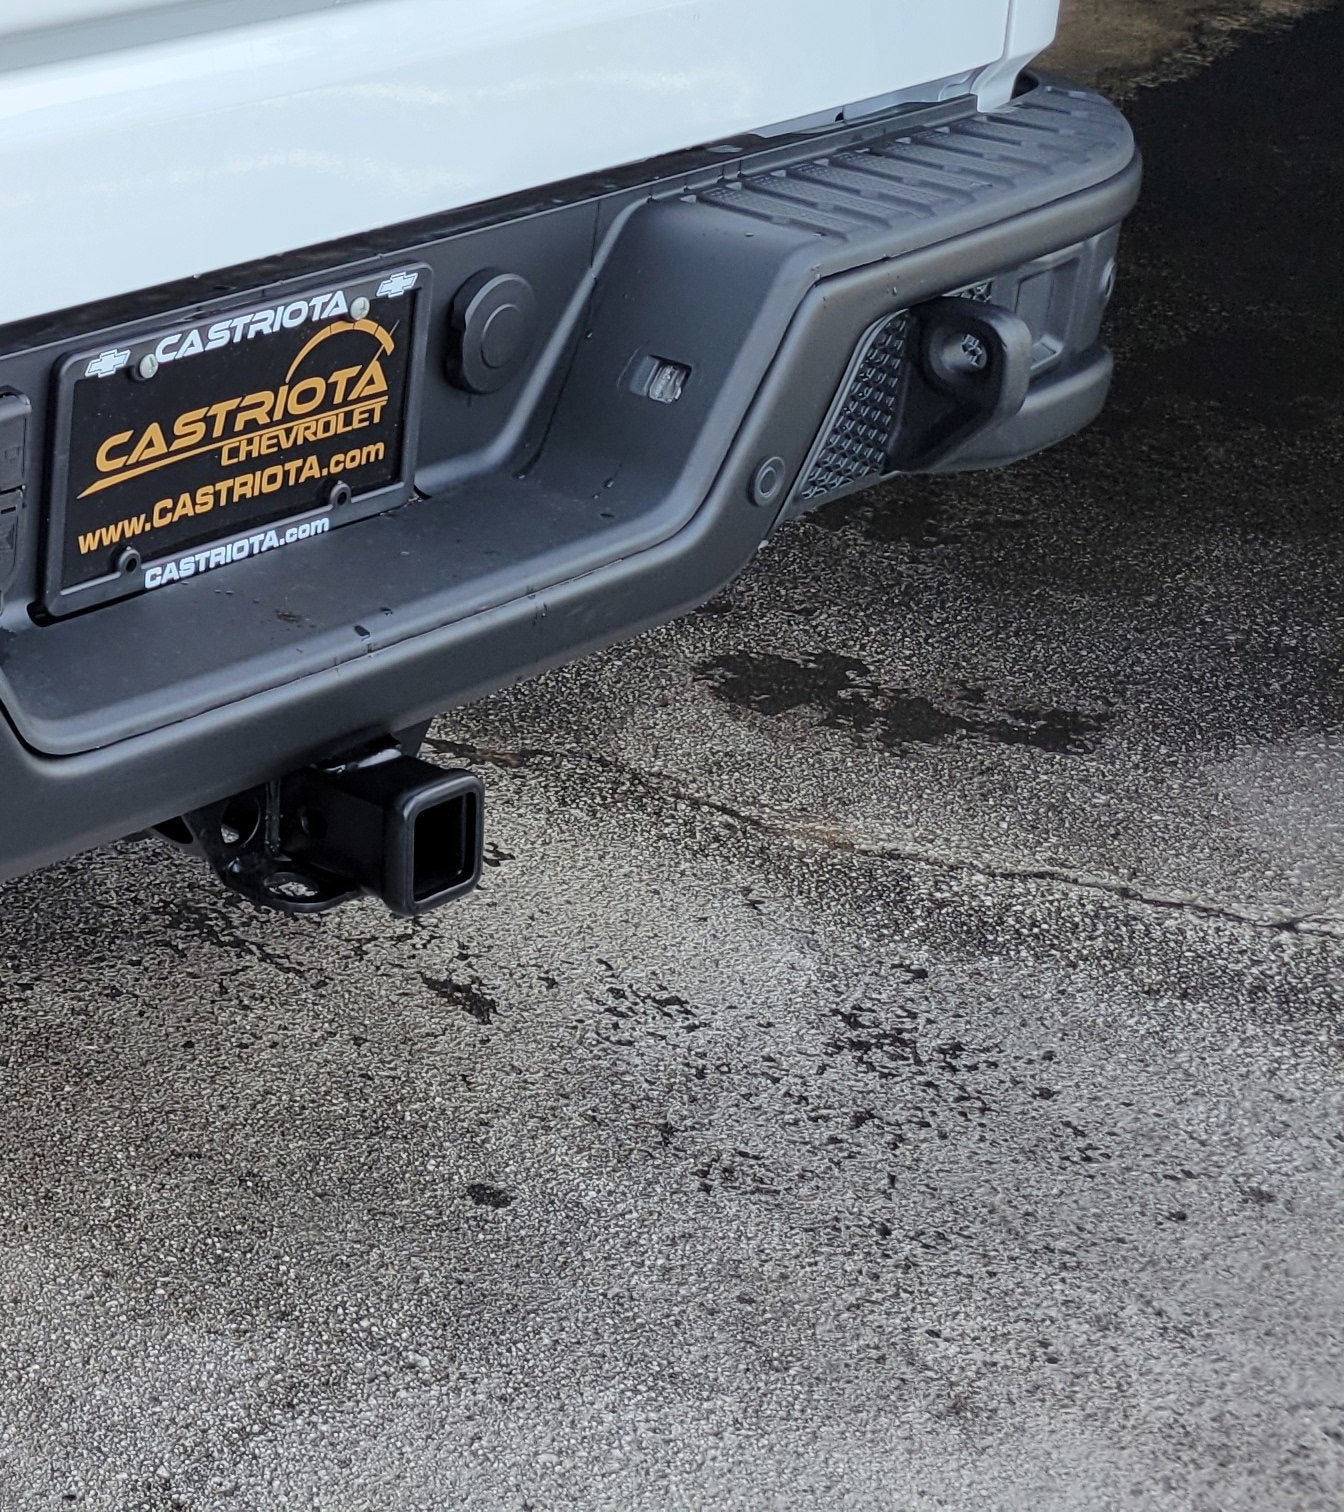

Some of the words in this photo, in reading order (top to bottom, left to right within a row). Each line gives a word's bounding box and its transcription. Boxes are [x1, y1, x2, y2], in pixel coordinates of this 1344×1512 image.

[155, 290, 348, 363] CASTRIOTA
[95, 360, 389, 472] CASTRIOTA
[220, 399, 388, 467] CHEVROLET
[78, 441, 385, 555] www.CASTRIOTA.com
[144, 517, 330, 589] CASTRIOTA.com
